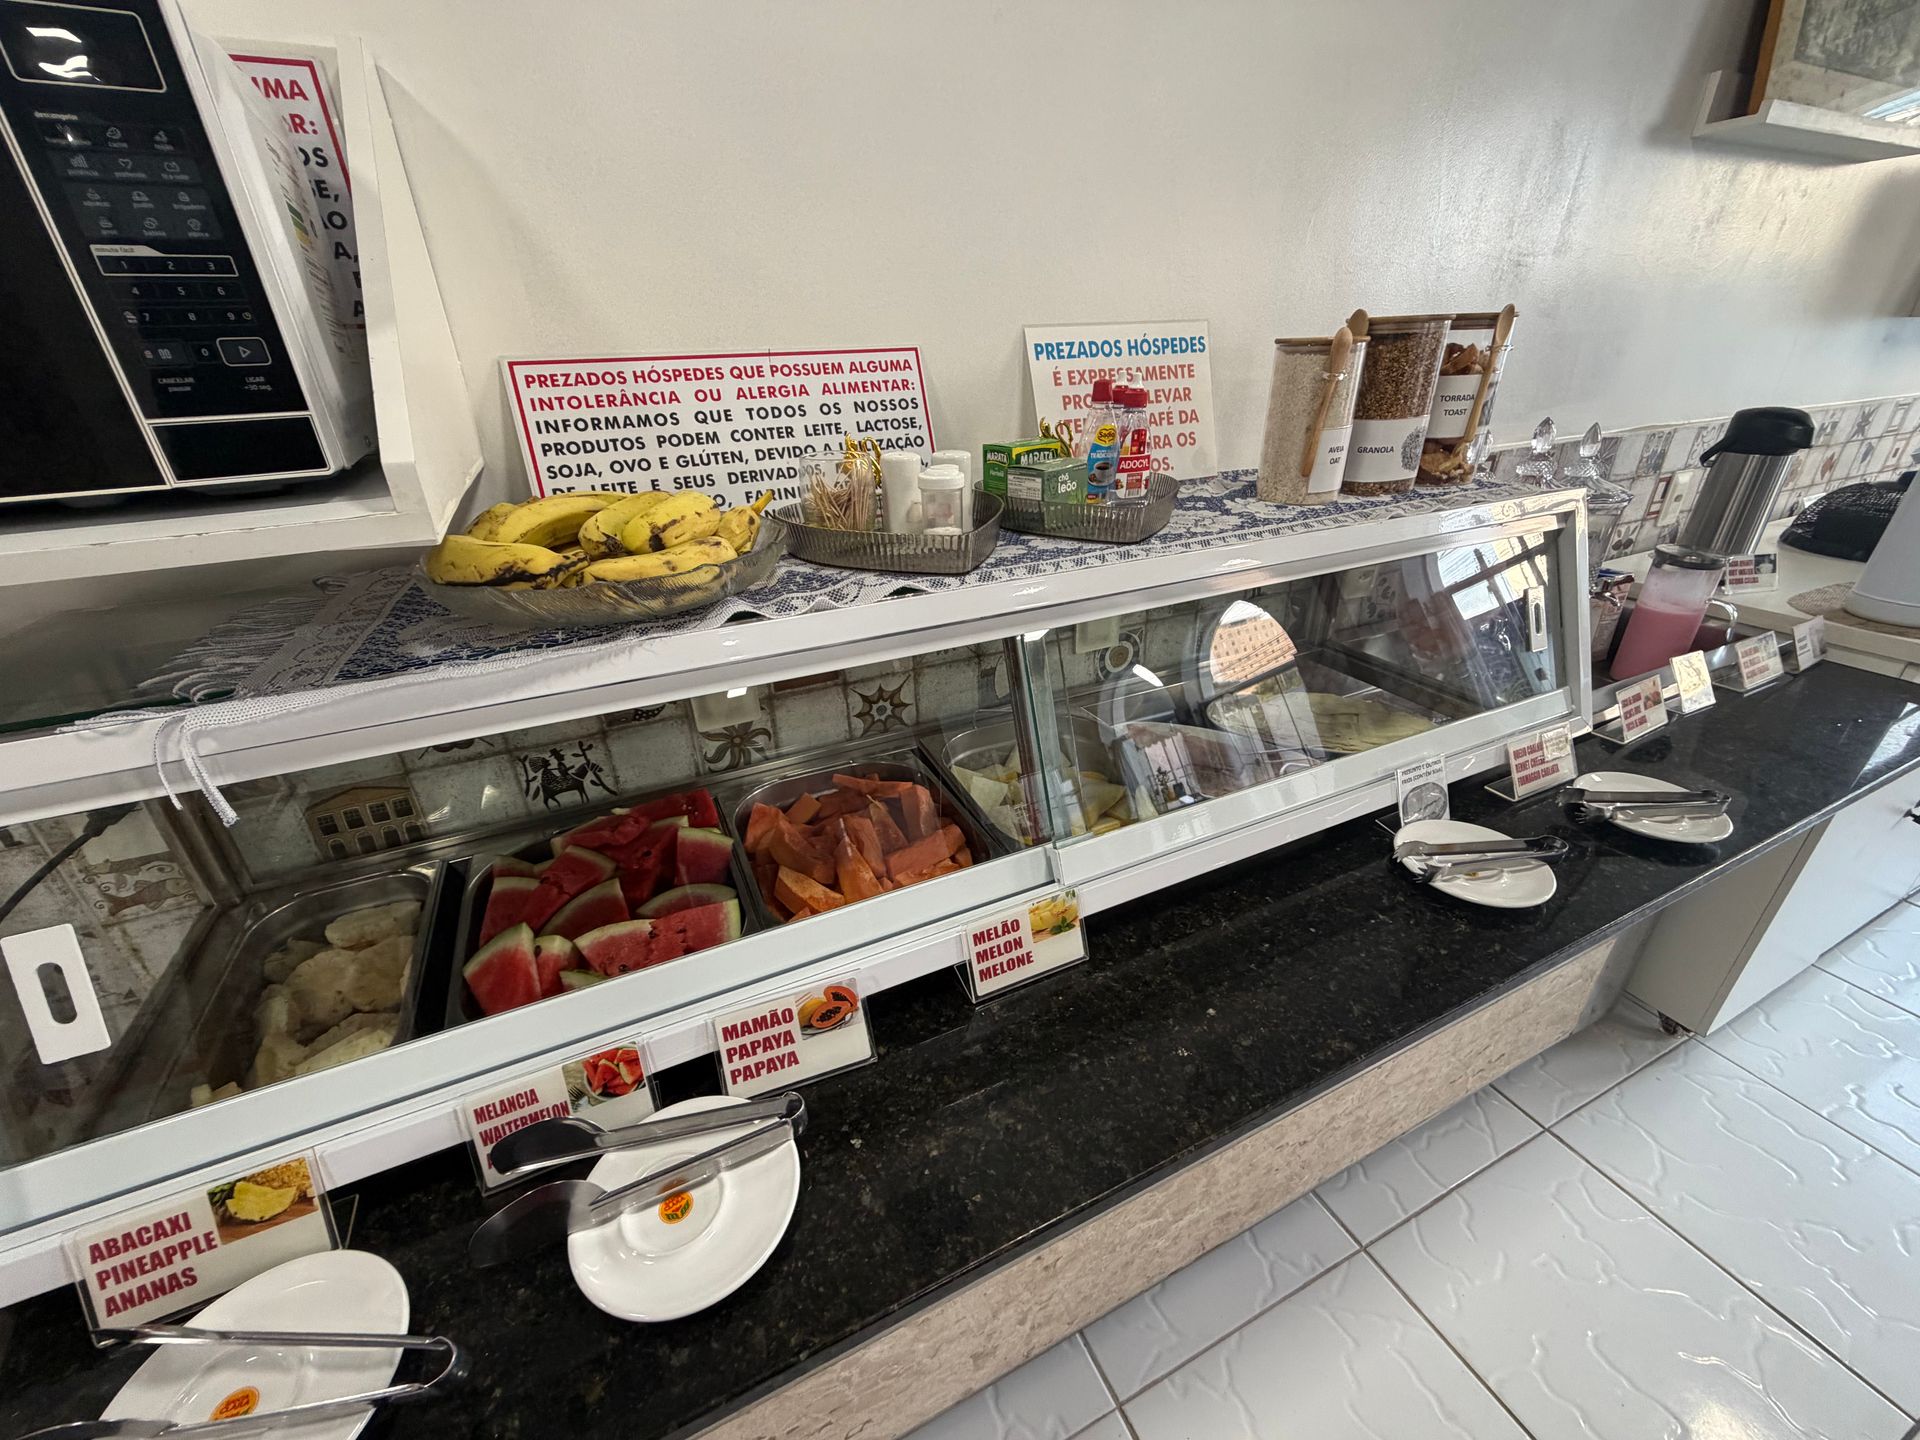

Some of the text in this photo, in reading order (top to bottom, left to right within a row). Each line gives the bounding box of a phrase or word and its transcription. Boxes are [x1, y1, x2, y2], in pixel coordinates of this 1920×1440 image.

[168, 261, 175, 270] 2
[208, 262, 215, 270] 3
[131, 287, 225, 295] 4 5 6
[143, 312, 235, 321] 7 8 9
[1034, 333, 1206, 360] PREZADOS HÓSPEDES
[524, 359, 912, 389] PREZADOS HÓSPEDES QUE POSSUEM ALGUMA
[1052, 366, 1063, 386] É
[530, 379, 915, 411] INTOLERÂNCIA OU ALERGIA ALIMENTAR:
[1146, 387, 1192, 404] LEVAR
[1440, 394, 1475, 402] TORRADA
[536, 397, 918, 434] INFORMAMOS QUE TODOS OS NOSSOS
[1149, 406, 1174, 427] AFÉ
[1179, 409, 1199, 425] DA
[1444, 408, 1467, 416] TOAST
[541, 417, 922, 457] PRODUTOS PODEM CONTER LEITE, LACTOSE,
[1177, 431, 1196, 447] OS
[1357, 446, 1395, 454] GRANOLA
[546, 463, 603, 479] SOJA,
[610, 458, 651, 474] OVO
[659, 457, 669, 470] E
[676, 449, 749, 468] GLÚTEN,
[755, 444, 816, 461] DEVIDO
[823, 443, 834, 456] A
[1120, 459, 1149, 470] ADOCYL
[651, 479, 661, 491] E
[673, 474, 716, 490] SEUS
[1058, 480, 1077, 493] leão
[972, 919, 1020, 947] MELÃO
[975, 936, 1024, 964] MELON
[978, 951, 1034, 982] MELONE
[722, 1007, 794, 1043] MAMÃO
[726, 1029, 796, 1064] PAPAYA
[730, 1050, 799, 1085] PAPAYA
[473, 1088, 539, 1125] MELANCIA
[88, 1211, 192, 1265] ABACAXI
[96, 1231, 218, 1291] PINEAPPLE
[105, 1267, 198, 1318] ANANAS
